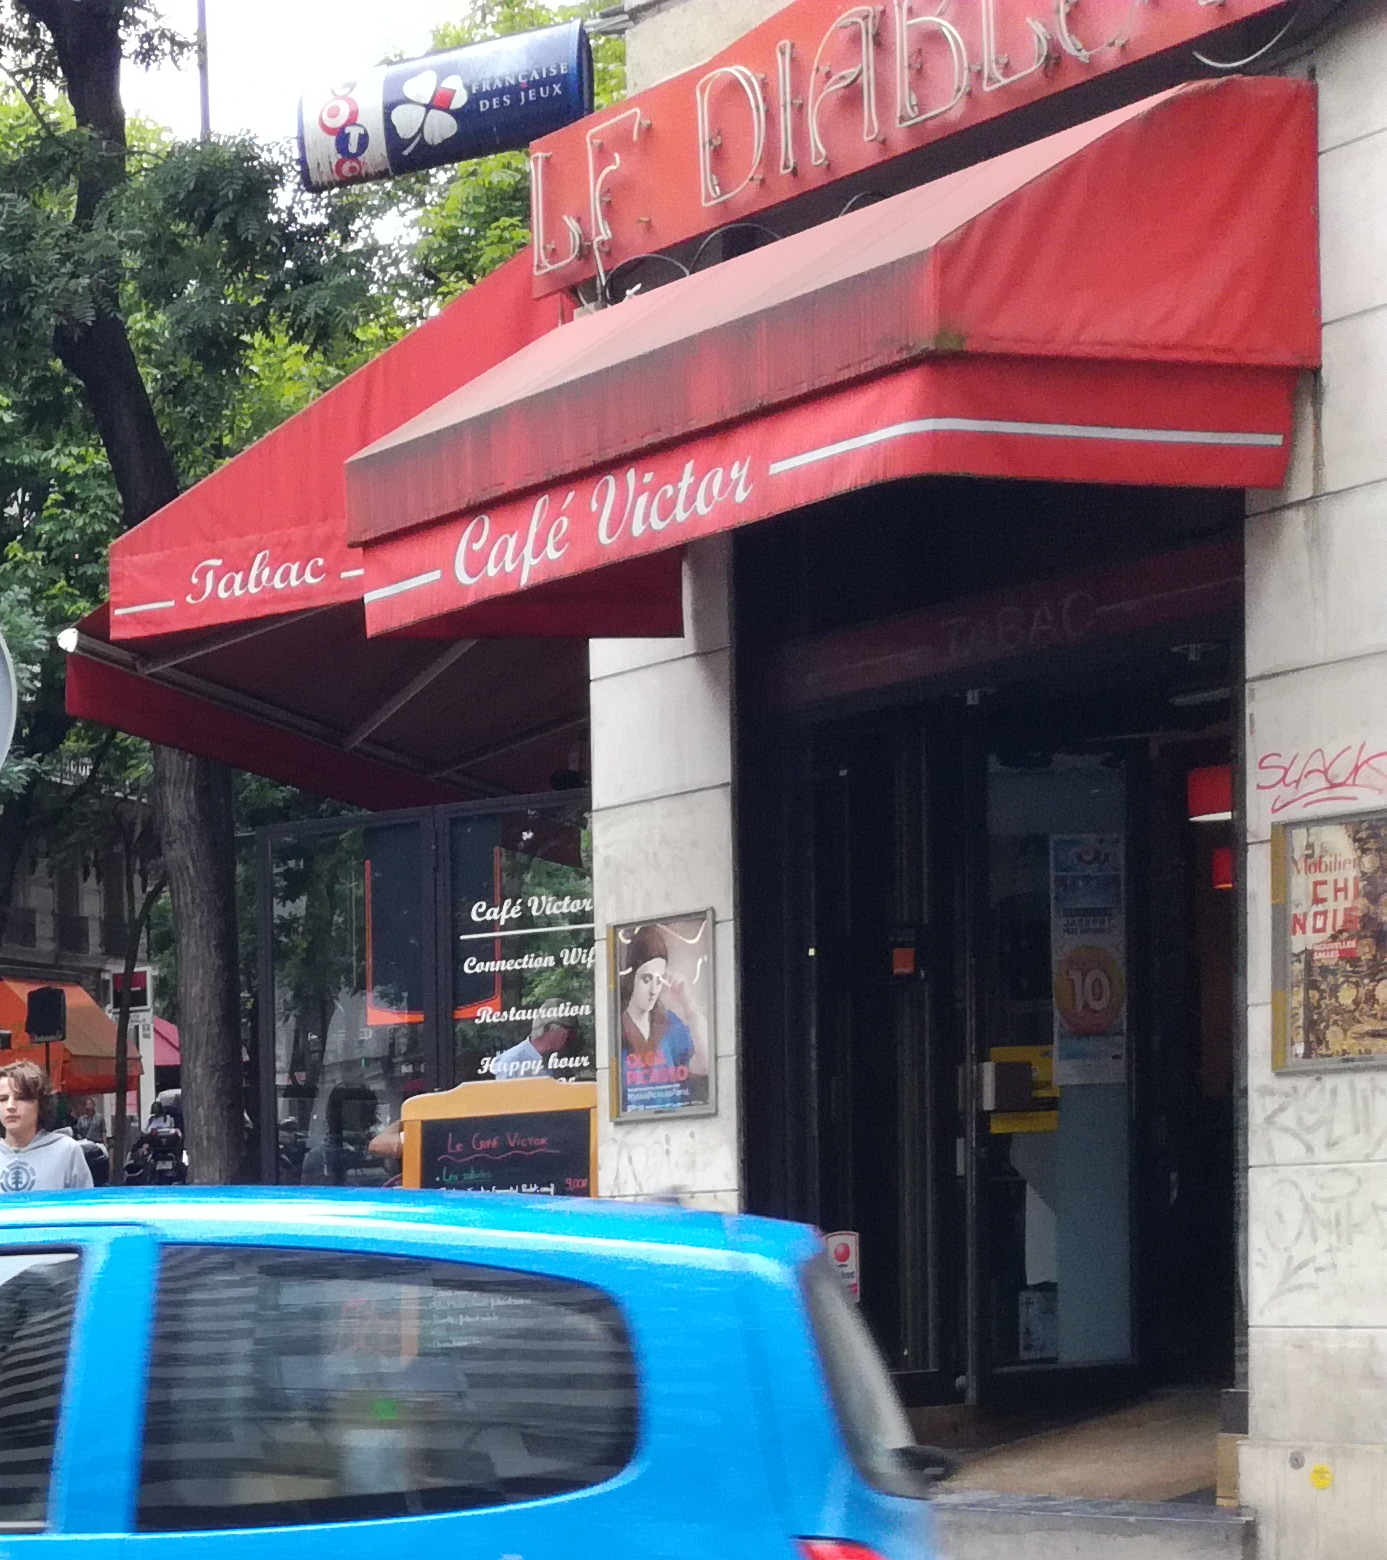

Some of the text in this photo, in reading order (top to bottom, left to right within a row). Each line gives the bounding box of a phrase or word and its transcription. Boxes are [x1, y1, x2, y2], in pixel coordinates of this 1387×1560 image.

[471, 63, 569, 93] FRANÇAISE
[479, 83, 563, 112] DES JEUX
[453, 454, 753, 587] Café Victor
[185, 548, 327, 605] Tabac
[1293, 854, 1360, 876] Mobilier
[1312, 876, 1361, 904] CHI
[470, 896, 594, 926] Café Victor
[1291, 905, 1360, 936] NOIS
[463, 947, 596, 974] Connection Wif
[1068, 968, 1112, 1014] 10
[474, 1001, 592, 1025] Restauration
[477, 1052, 590, 1077] Happy hour
